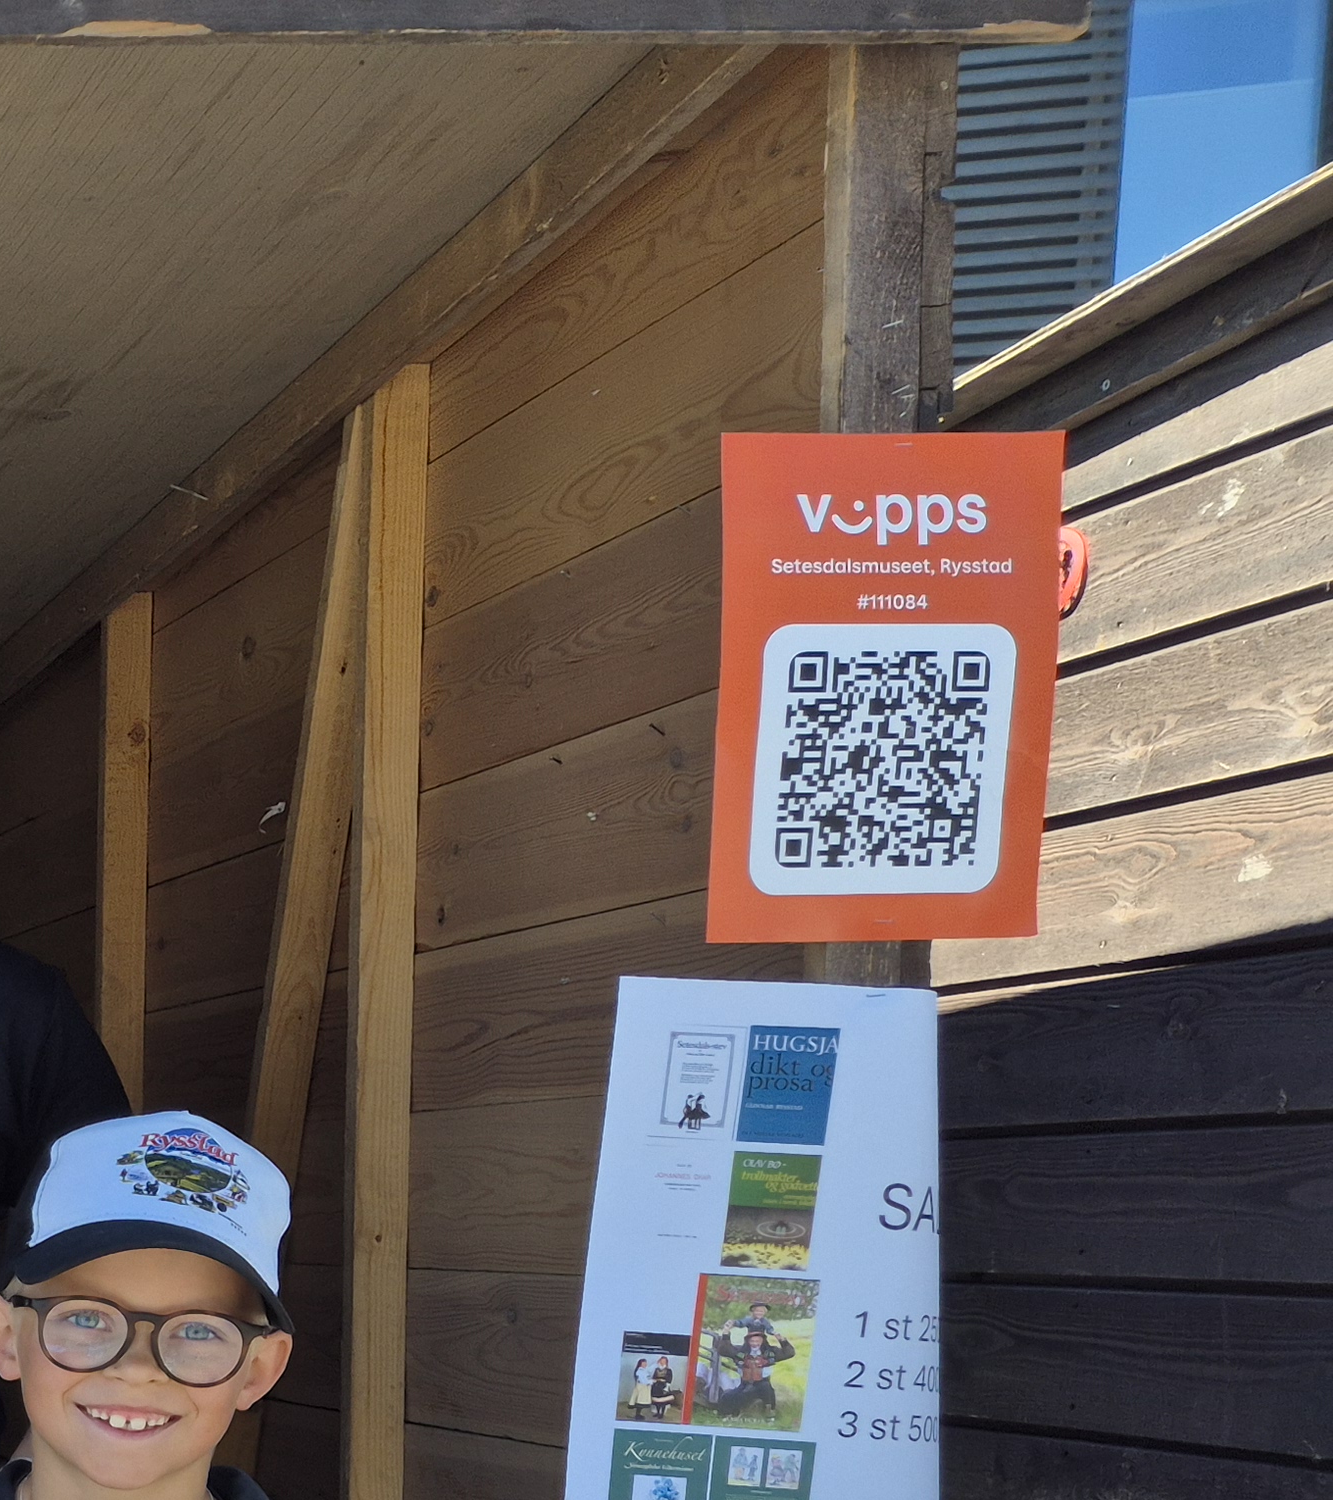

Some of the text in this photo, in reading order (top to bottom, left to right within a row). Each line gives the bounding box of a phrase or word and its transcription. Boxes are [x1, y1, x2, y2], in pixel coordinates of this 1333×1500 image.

[771, 558, 1013, 577] Setesdalsmuseet, Rysstad
[856, 593, 928, 610] #111084
[750, 1053, 801, 1075] dikt
[746, 1075, 814, 1098] prosa
[878, 1182, 940, 1235] SA
[855, 1311, 868, 1338] 1
[883, 1316, 912, 1342] st
[843, 1360, 866, 1388] 2
[876, 1366, 906, 1392] st
[837, 1410, 858, 1438] 3
[869, 1413, 900, 1442] st
